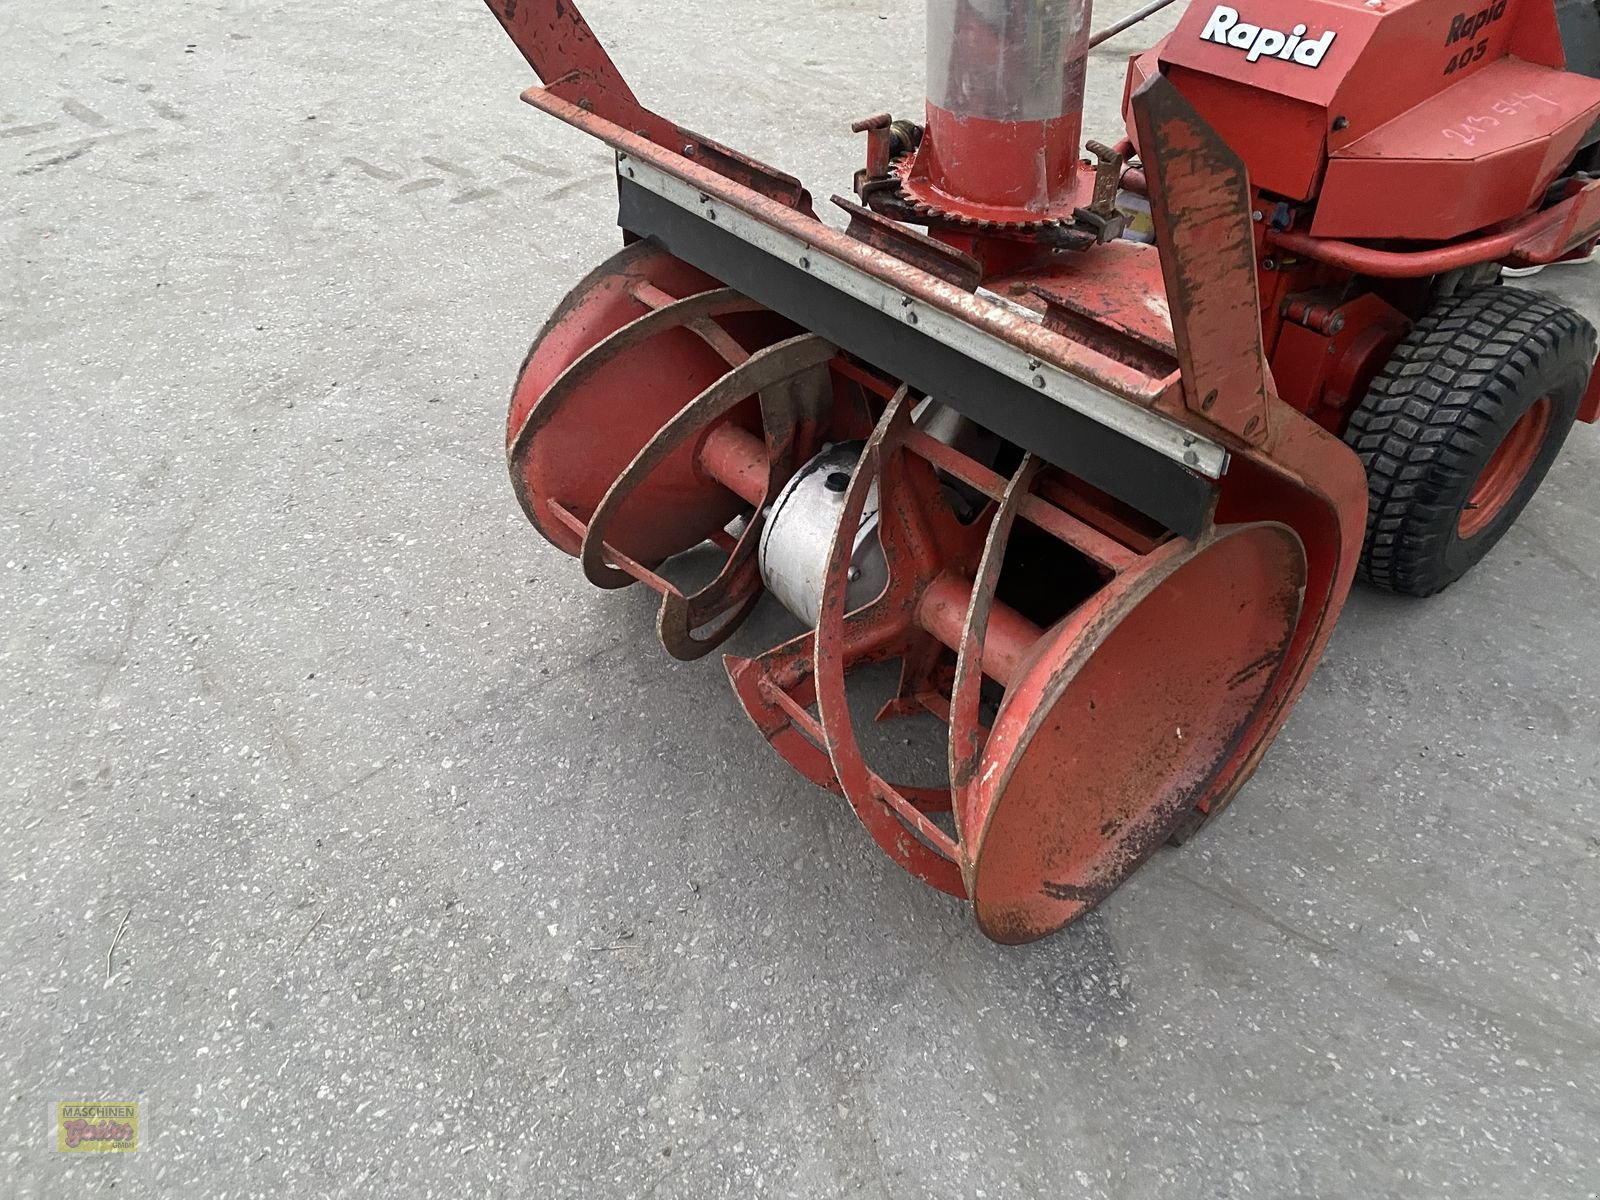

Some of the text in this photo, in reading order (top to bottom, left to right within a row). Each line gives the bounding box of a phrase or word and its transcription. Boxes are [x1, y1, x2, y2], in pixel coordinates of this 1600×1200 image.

[1200, 4, 1337, 69] Rapid
[1444, 0, 1507, 48] Rapid
[1443, 37, 1489, 76] 405
